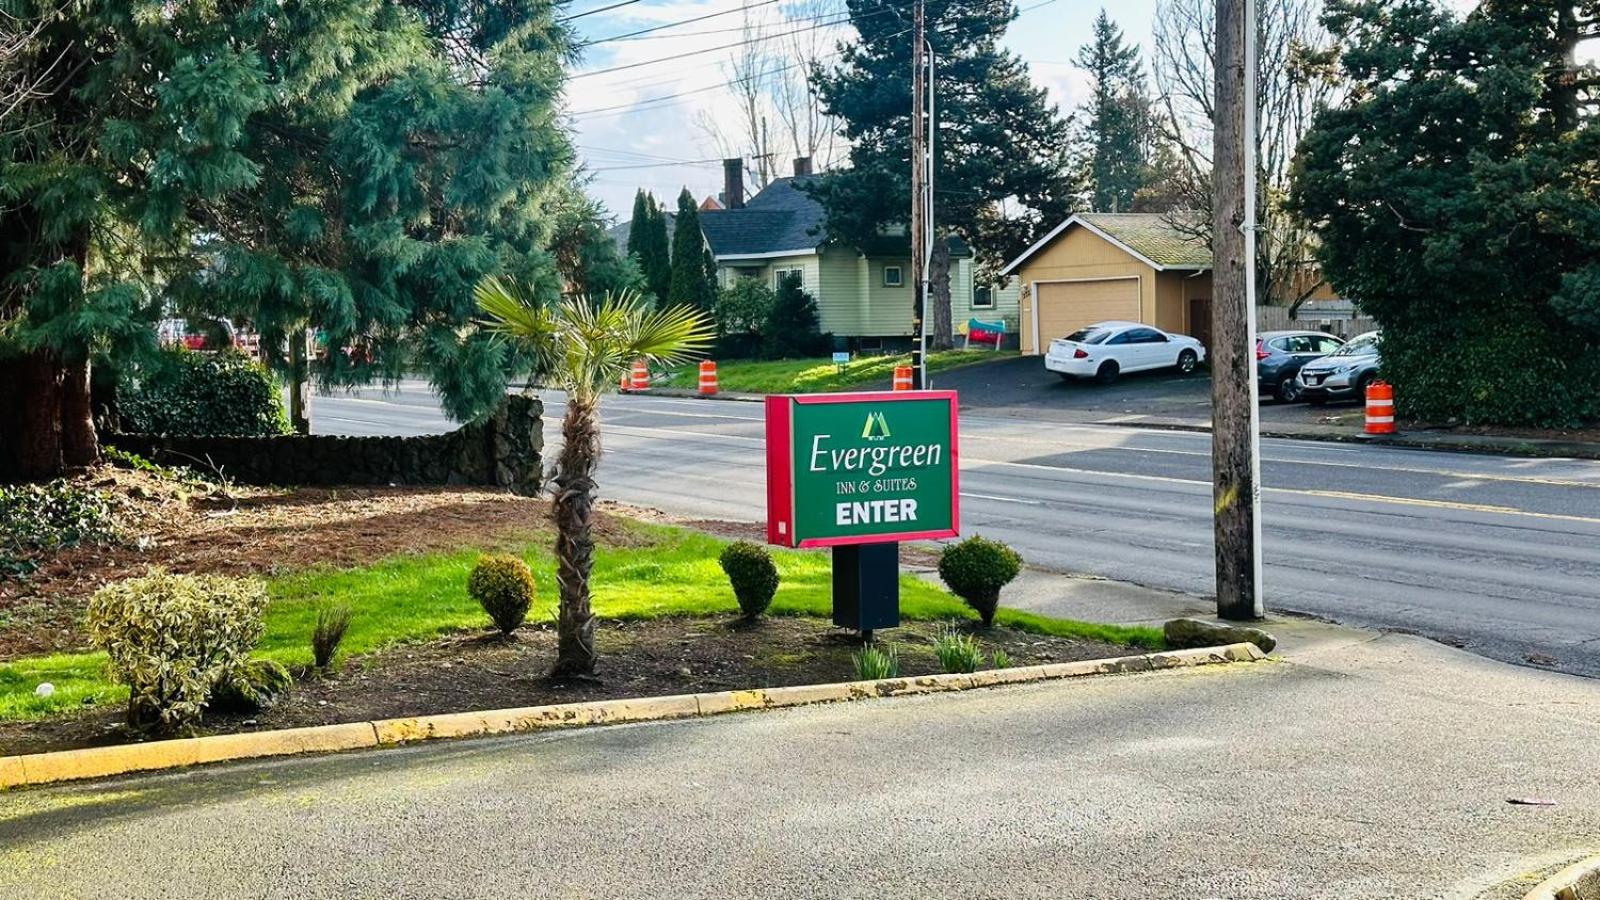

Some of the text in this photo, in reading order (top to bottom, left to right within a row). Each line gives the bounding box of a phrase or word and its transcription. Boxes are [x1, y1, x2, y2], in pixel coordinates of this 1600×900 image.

[809, 434, 941, 476] Evergreen
[836, 477, 917, 495] INN & SUITES
[836, 498, 918, 525] ENTER
